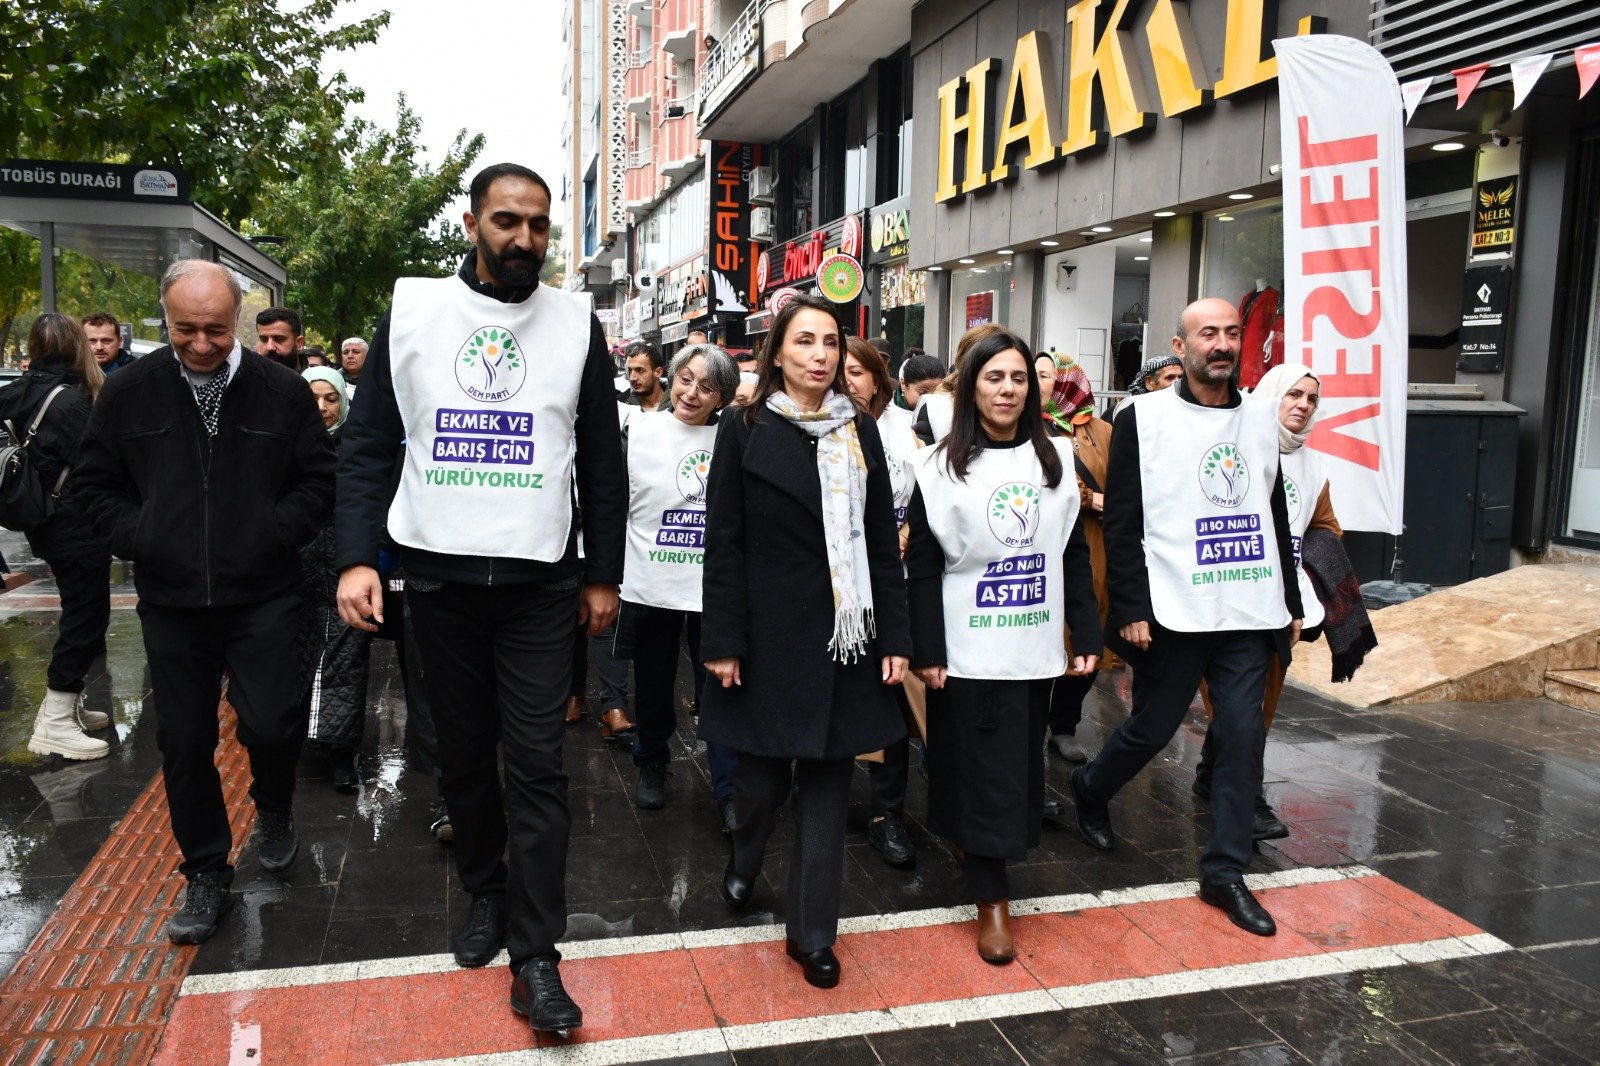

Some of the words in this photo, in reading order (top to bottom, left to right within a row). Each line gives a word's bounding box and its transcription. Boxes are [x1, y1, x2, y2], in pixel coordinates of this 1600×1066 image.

[1, 167, 55, 184] TOBÜS
[60, 172, 121, 189] DURAĞI
[716, 140, 745, 271] ŞAHİN
[1478, 207, 1511, 222] MELEK
[1475, 233, 1493, 245] KAT:2
[1494, 230, 1511, 243] NO:3
[467, 386, 484, 399] DEM
[486, 387, 510, 400] PARTİ
[440, 412, 501, 430] EKMEK
[507, 415, 529, 432] VE
[435, 441, 487, 463] BARIŞ
[492, 439, 530, 464] İÇİN
[425, 467, 544, 489] YÜRÜYORUZ
[1211, 494, 1227, 506] DEM
[665, 512, 706, 525] EKMEK
[1199, 522, 1207, 533] JI
[1210, 519, 1224, 531] BO
[1228, 518, 1248, 530] NAN
[1250, 514, 1257, 528] Û
[659, 531, 696, 548] BARIŞ
[1200, 534, 1261, 562] AŞTIYÊ
[648, 549, 705, 564] YÜRÜYO
[996, 561, 1013, 573] BO
[1035, 554, 1043, 568] Û
[1191, 571, 1214, 585] EM
[980, 577, 1042, 605] AŞTIYÊ
[969, 615, 992, 628] EM
[996, 610, 1050, 629] DIMEŞIN
